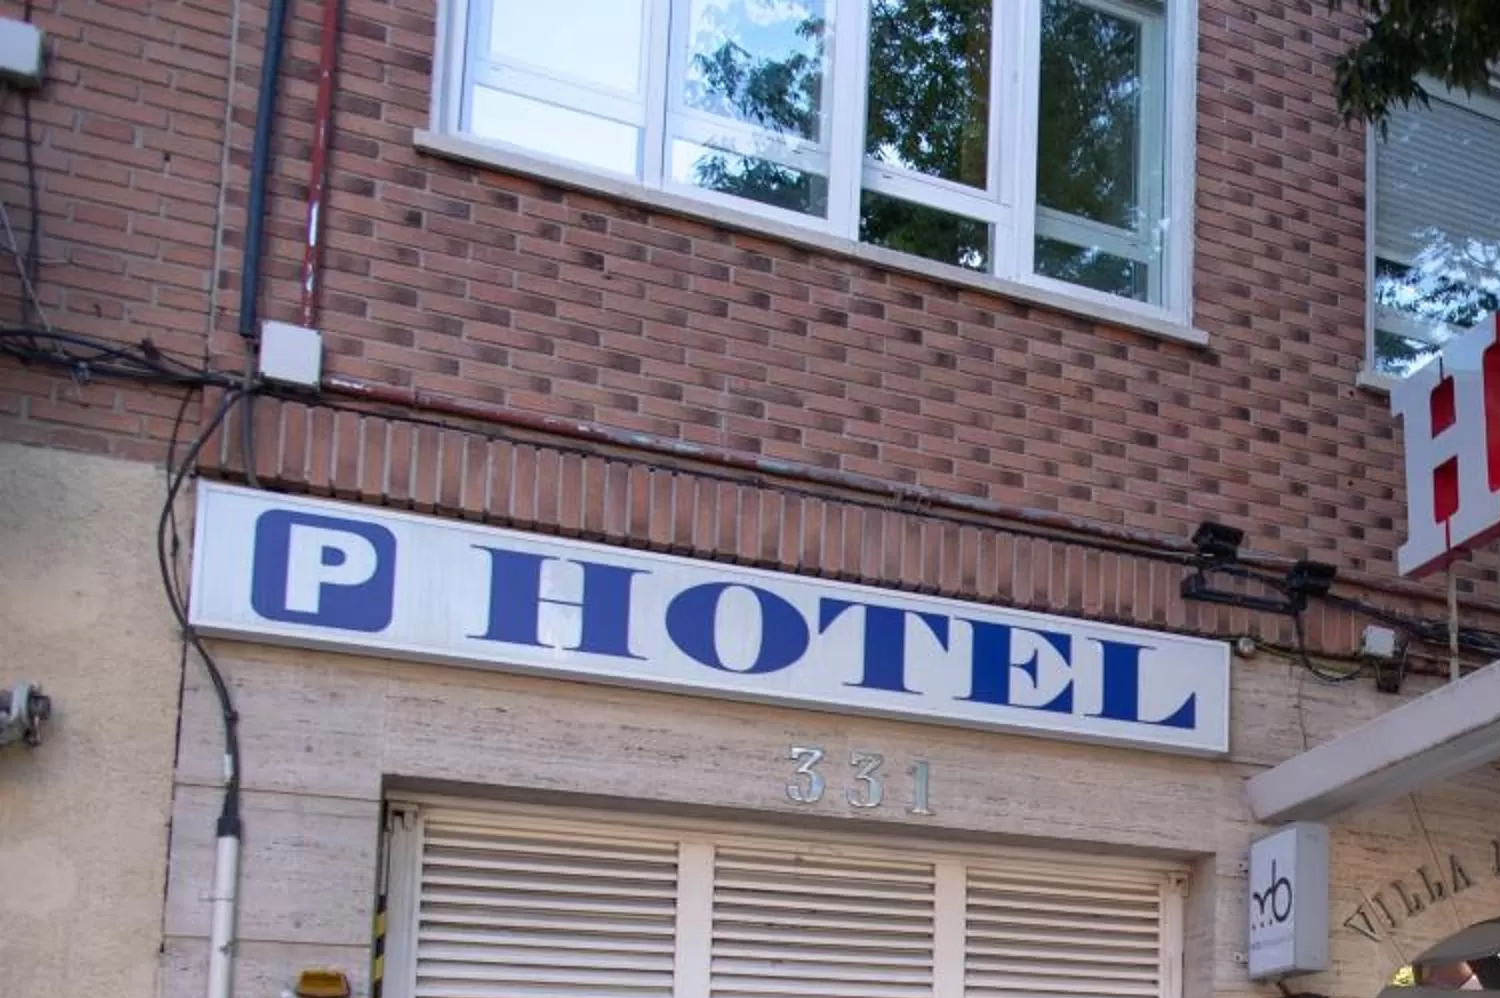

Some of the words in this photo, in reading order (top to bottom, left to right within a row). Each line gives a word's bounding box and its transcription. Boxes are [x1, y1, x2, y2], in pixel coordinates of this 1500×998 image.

[284, 522, 380, 615] P
[464, 543, 1197, 730] HOTEL
[784, 744, 937, 817] 331
[1343, 854, 1478, 942] VILLA
